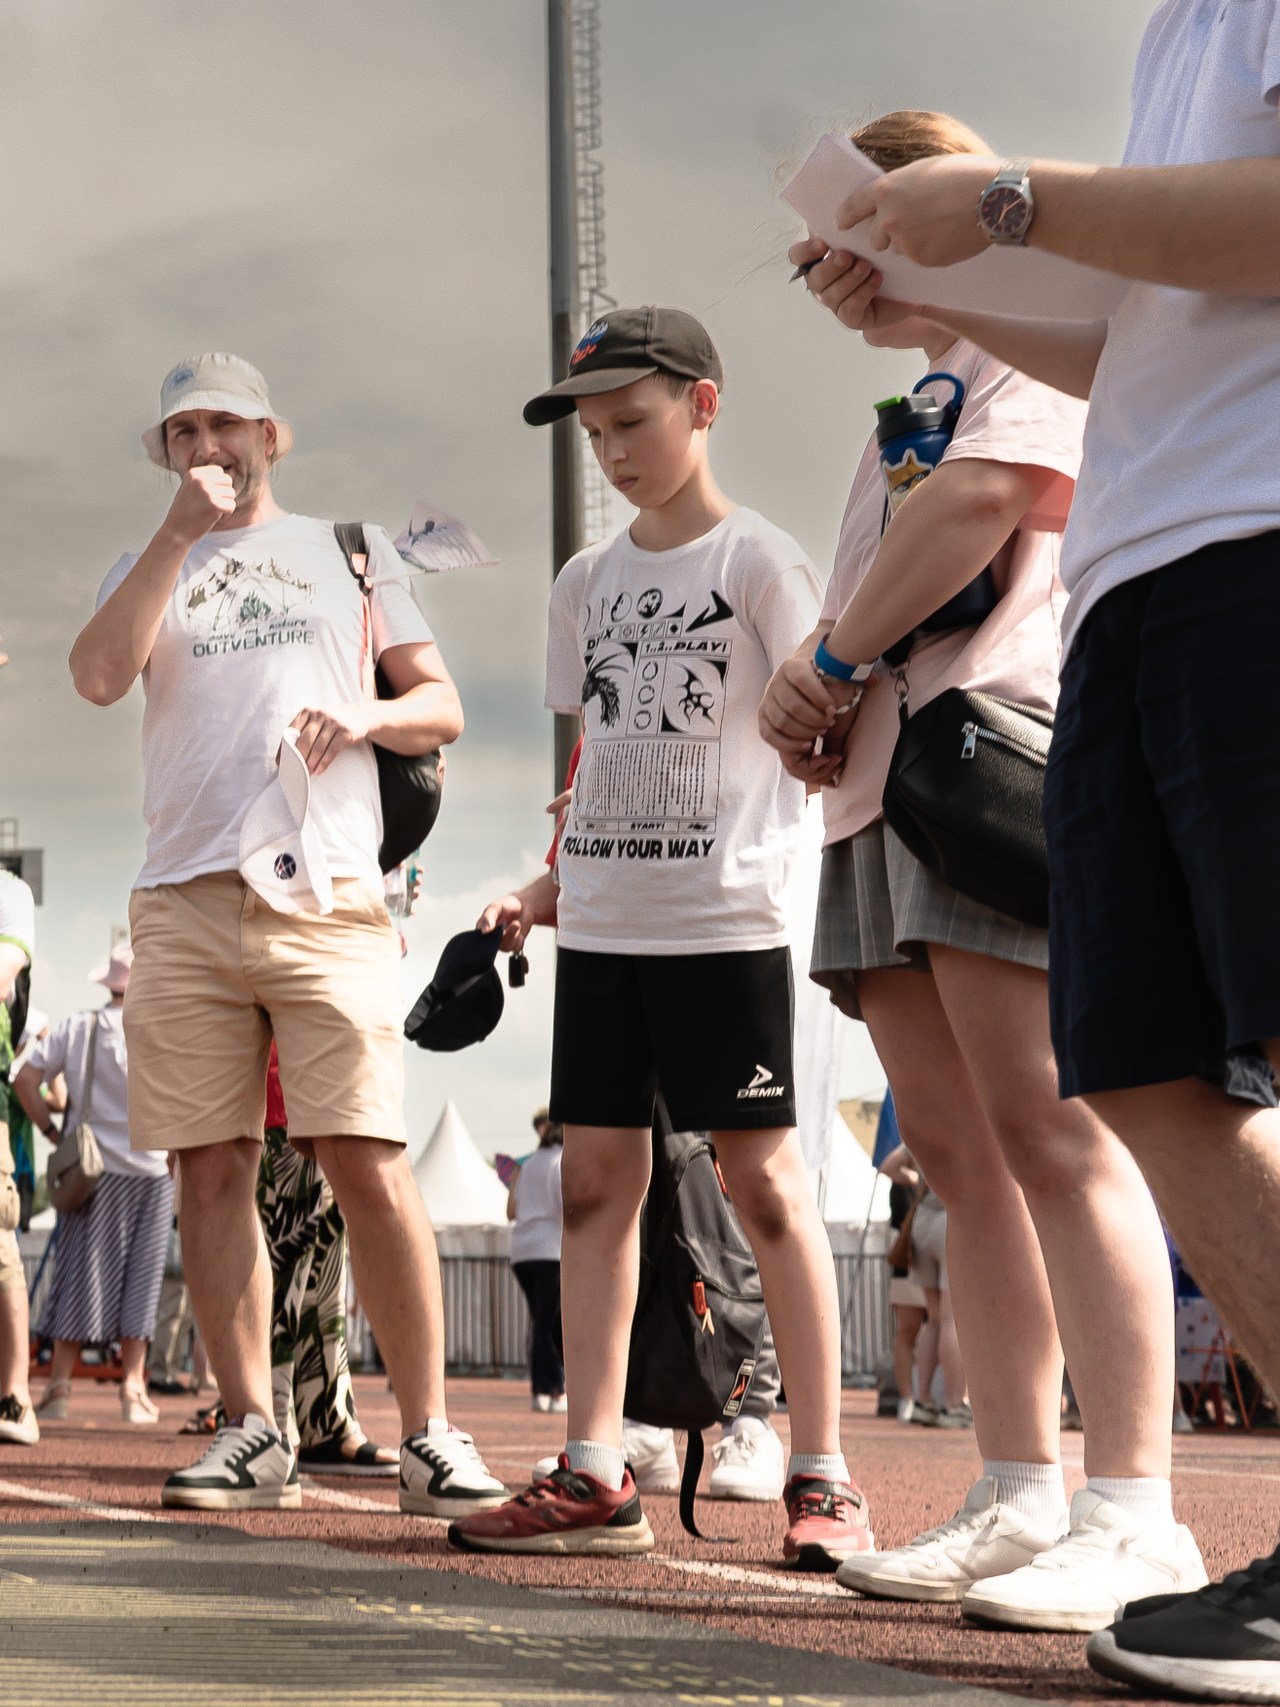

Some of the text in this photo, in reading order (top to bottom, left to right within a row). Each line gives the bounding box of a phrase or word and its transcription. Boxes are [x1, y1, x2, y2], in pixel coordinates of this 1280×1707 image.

[192, 629, 315, 659] OUTVENTURE
[562, 835, 716, 860] FOLLOW YOUR WAY
[736, 1085, 785, 1099] DEMIX
